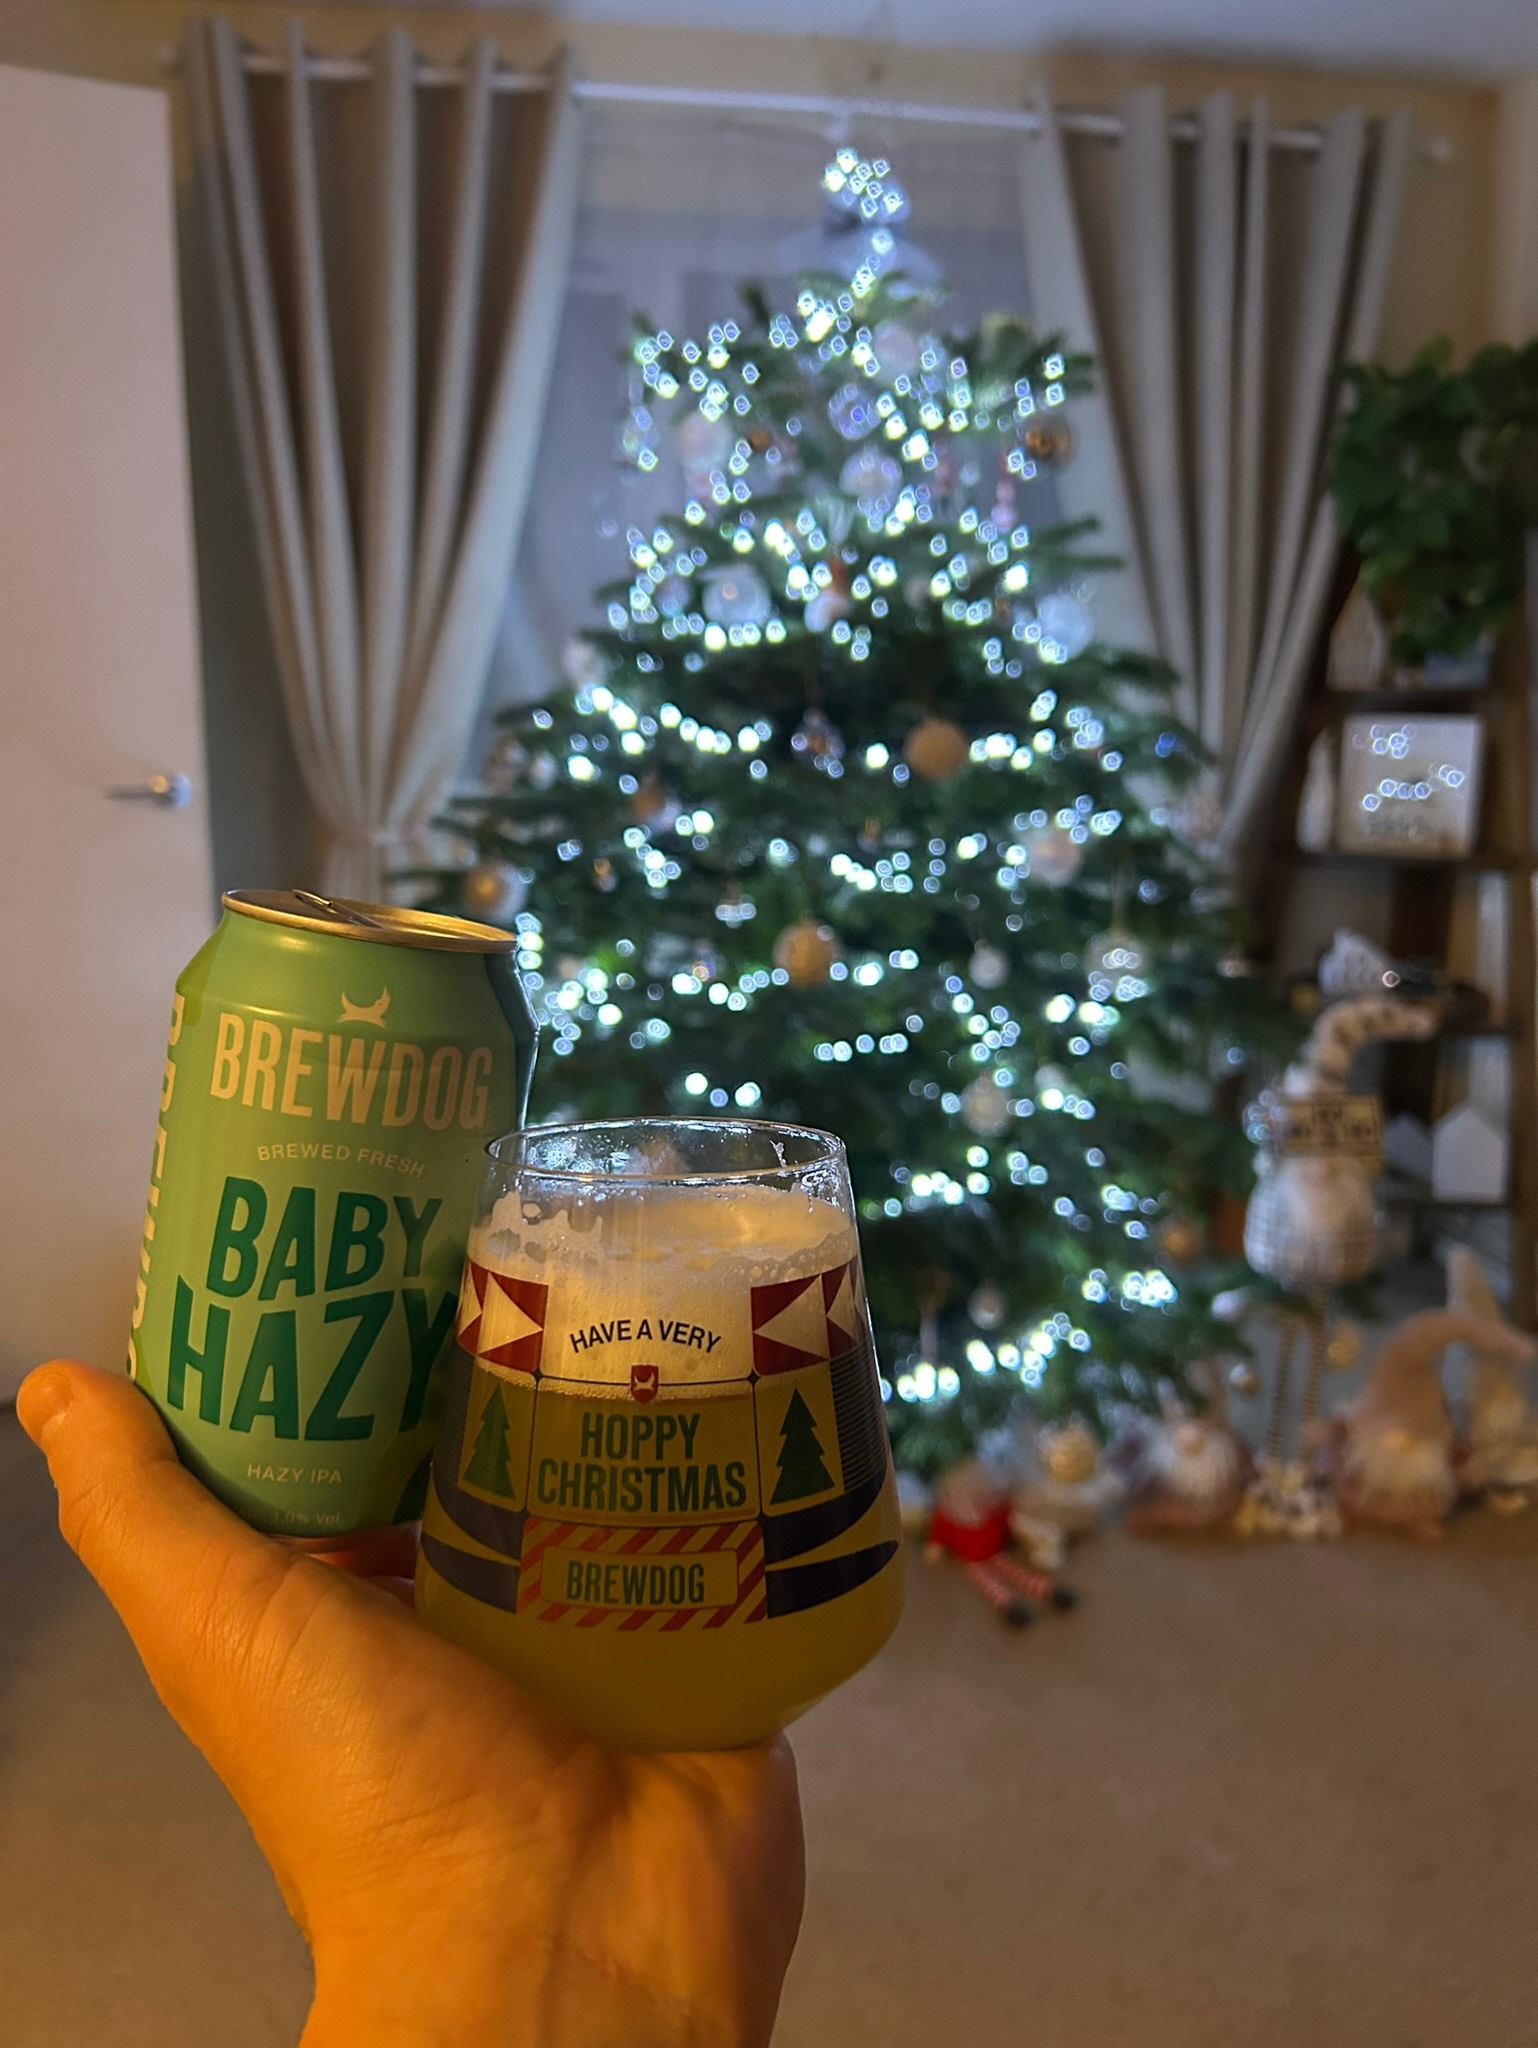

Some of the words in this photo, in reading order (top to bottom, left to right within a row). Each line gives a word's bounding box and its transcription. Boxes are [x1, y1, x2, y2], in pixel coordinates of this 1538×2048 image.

[210, 1012, 493, 1130] BREWDOG
[257, 1143, 350, 1161] BREWED
[357, 1149, 425, 1178] FRESH
[206, 1176, 443, 1301] BABY
[167, 1274, 458, 1441] HAZY
[570, 1319, 632, 1354] HAVE
[636, 1319, 653, 1340] A
[659, 1319, 722, 1354] VERY
[580, 1412, 701, 1461] HOPPY
[247, 1463, 304, 1483] HAZY
[310, 1469, 342, 1484] IPA
[536, 1458, 747, 1513] CHRISTMAS
[566, 1560, 705, 1605] BREWDOG
